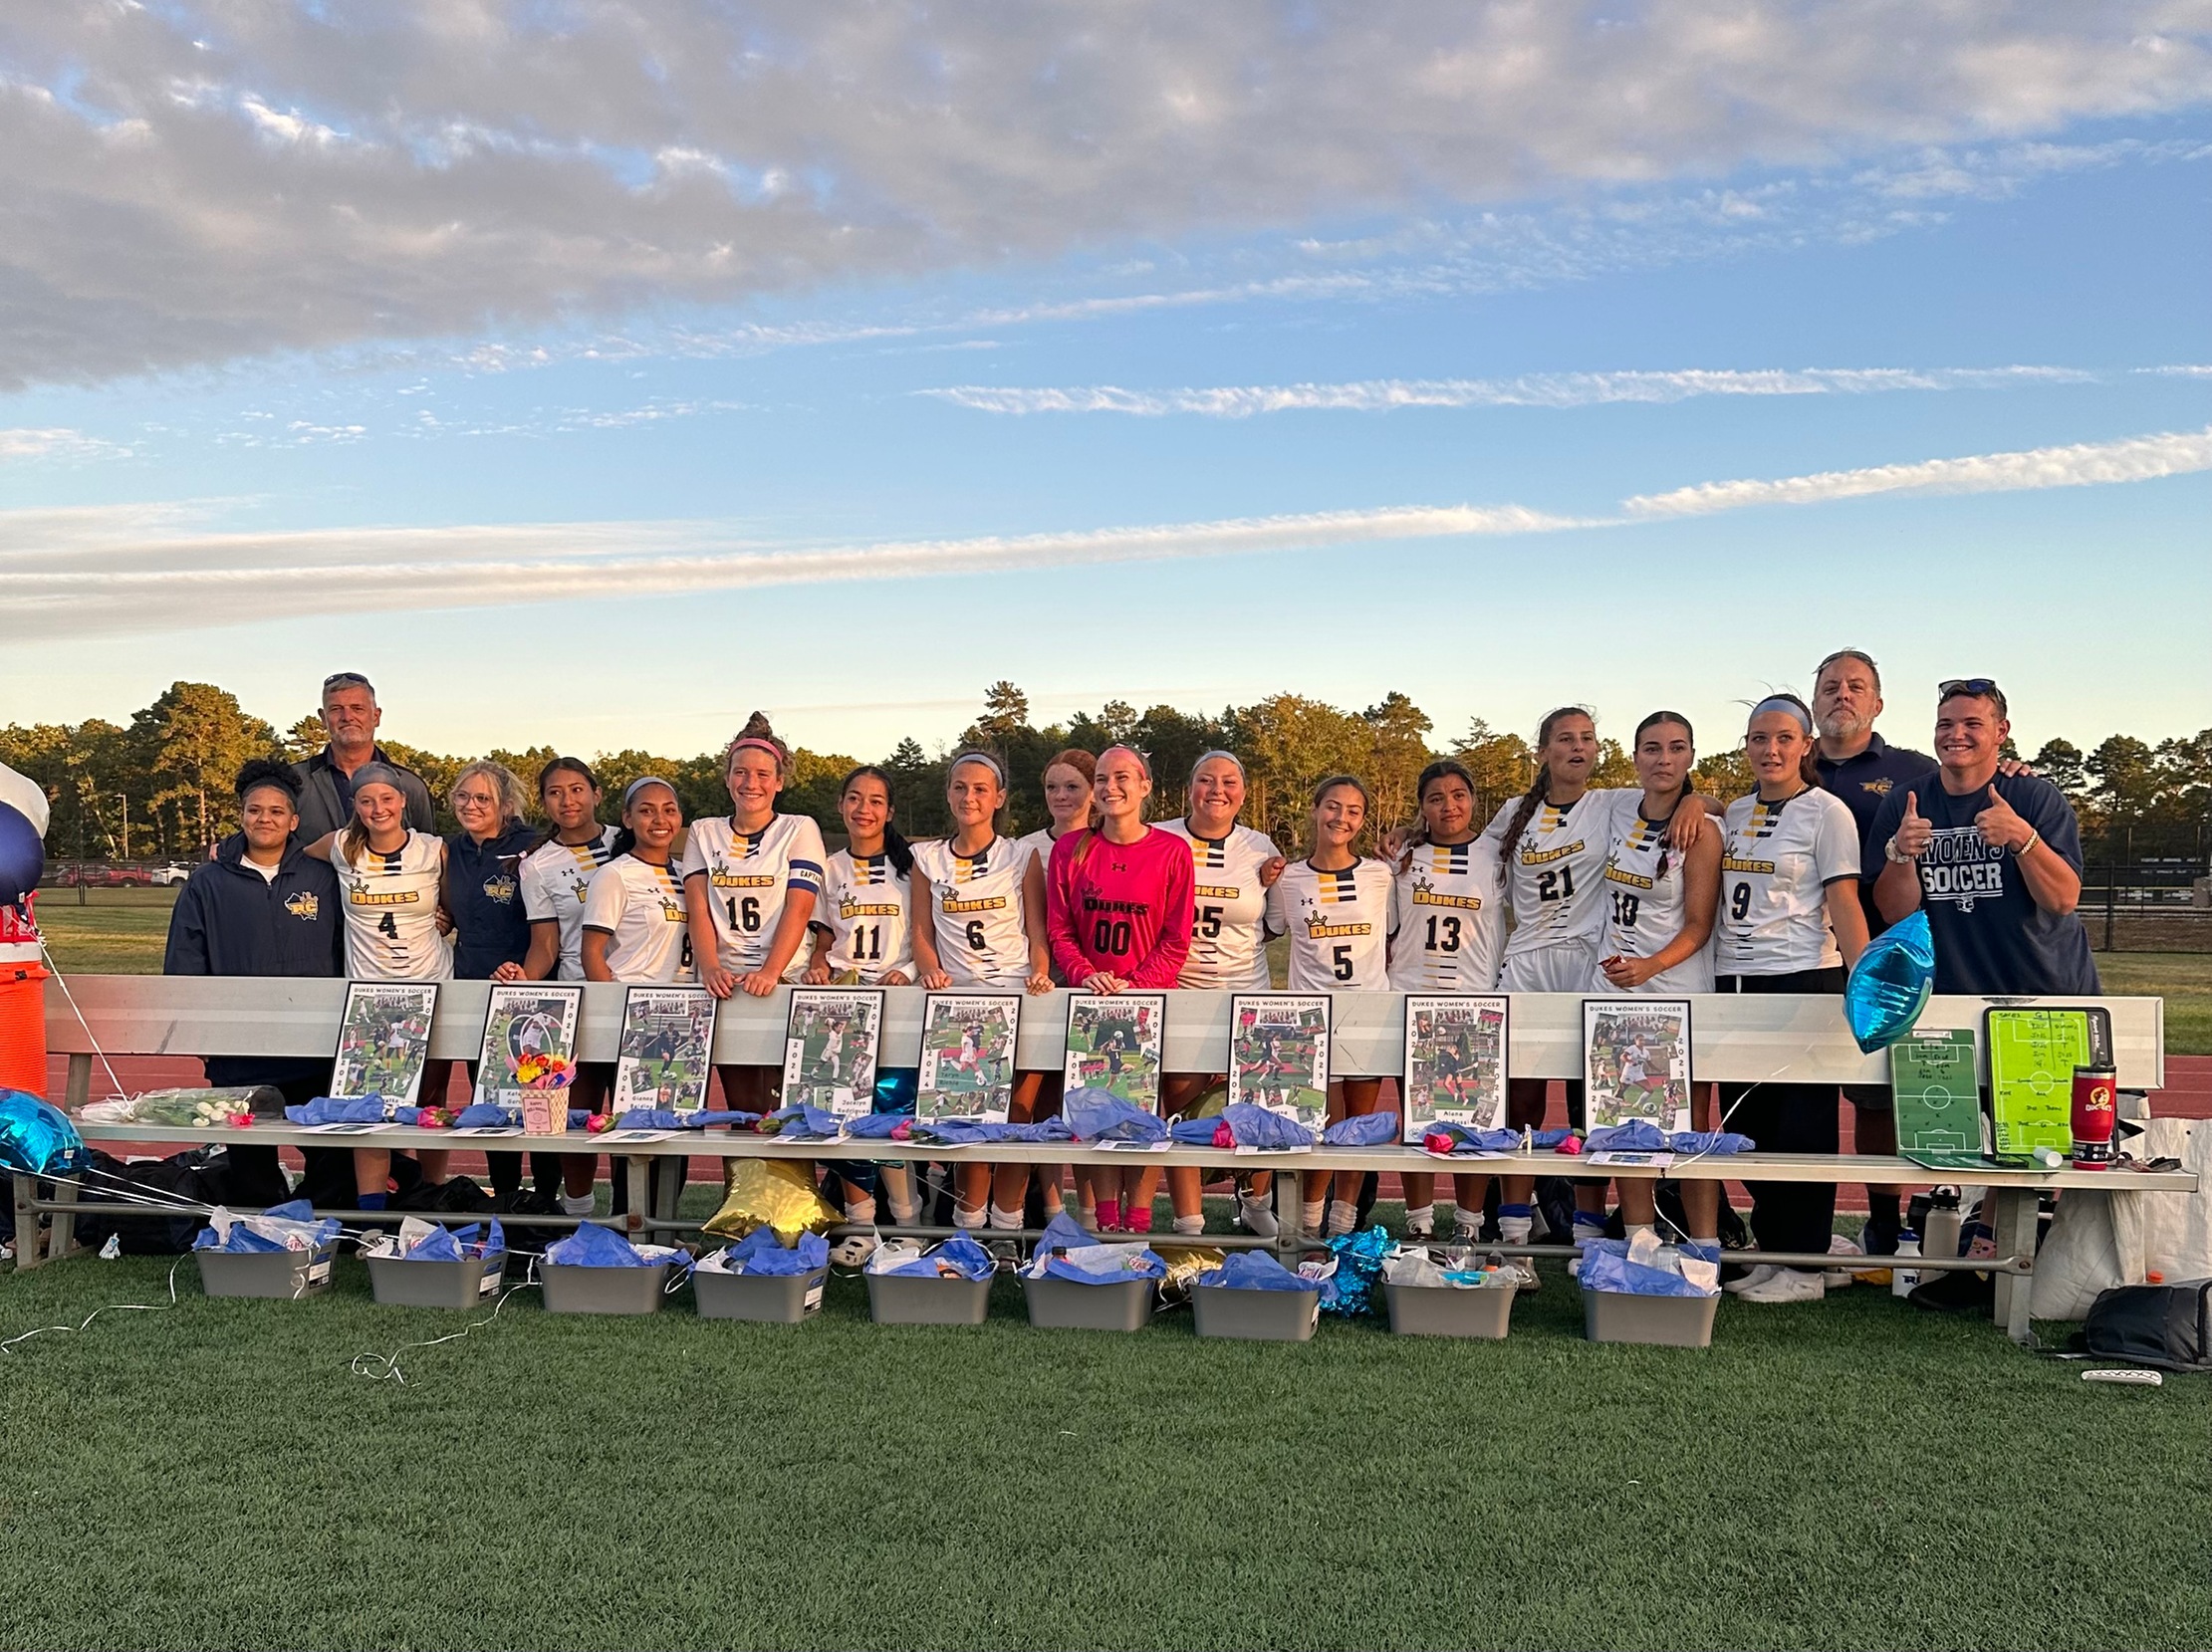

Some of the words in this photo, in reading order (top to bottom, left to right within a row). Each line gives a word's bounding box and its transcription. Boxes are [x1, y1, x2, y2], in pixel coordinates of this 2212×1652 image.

[1522, 839, 1585, 865] DUKES
[1722, 856, 1775, 874] DUKES
[712, 874, 774, 887] DUKES
[1537, 865, 1576, 901] 21
[1604, 865, 1653, 889] DUKES
[1921, 862, 2003, 892] SOCCER
[291, 900, 318, 915] RC
[351, 891, 419, 905] DUKES
[841, 904, 899, 919] DUKES
[942, 896, 1006, 913] DUKES
[1084, 897, 1149, 914] DUKES
[1412, 891, 1482, 910] DUKES
[1611, 890, 1639, 926] 10
[1732, 882, 1751, 920] 9
[377, 912, 398, 939] 4
[726, 896, 760, 931] 16
[853, 925, 880, 959] 11
[966, 920, 986, 950] 6
[1095, 919, 1131, 956] 00
[1310, 923, 1371, 939] DUKES
[1424, 914, 1461, 952] 13
[681, 932, 693, 967] 8
[1333, 945, 1353, 981] 5
